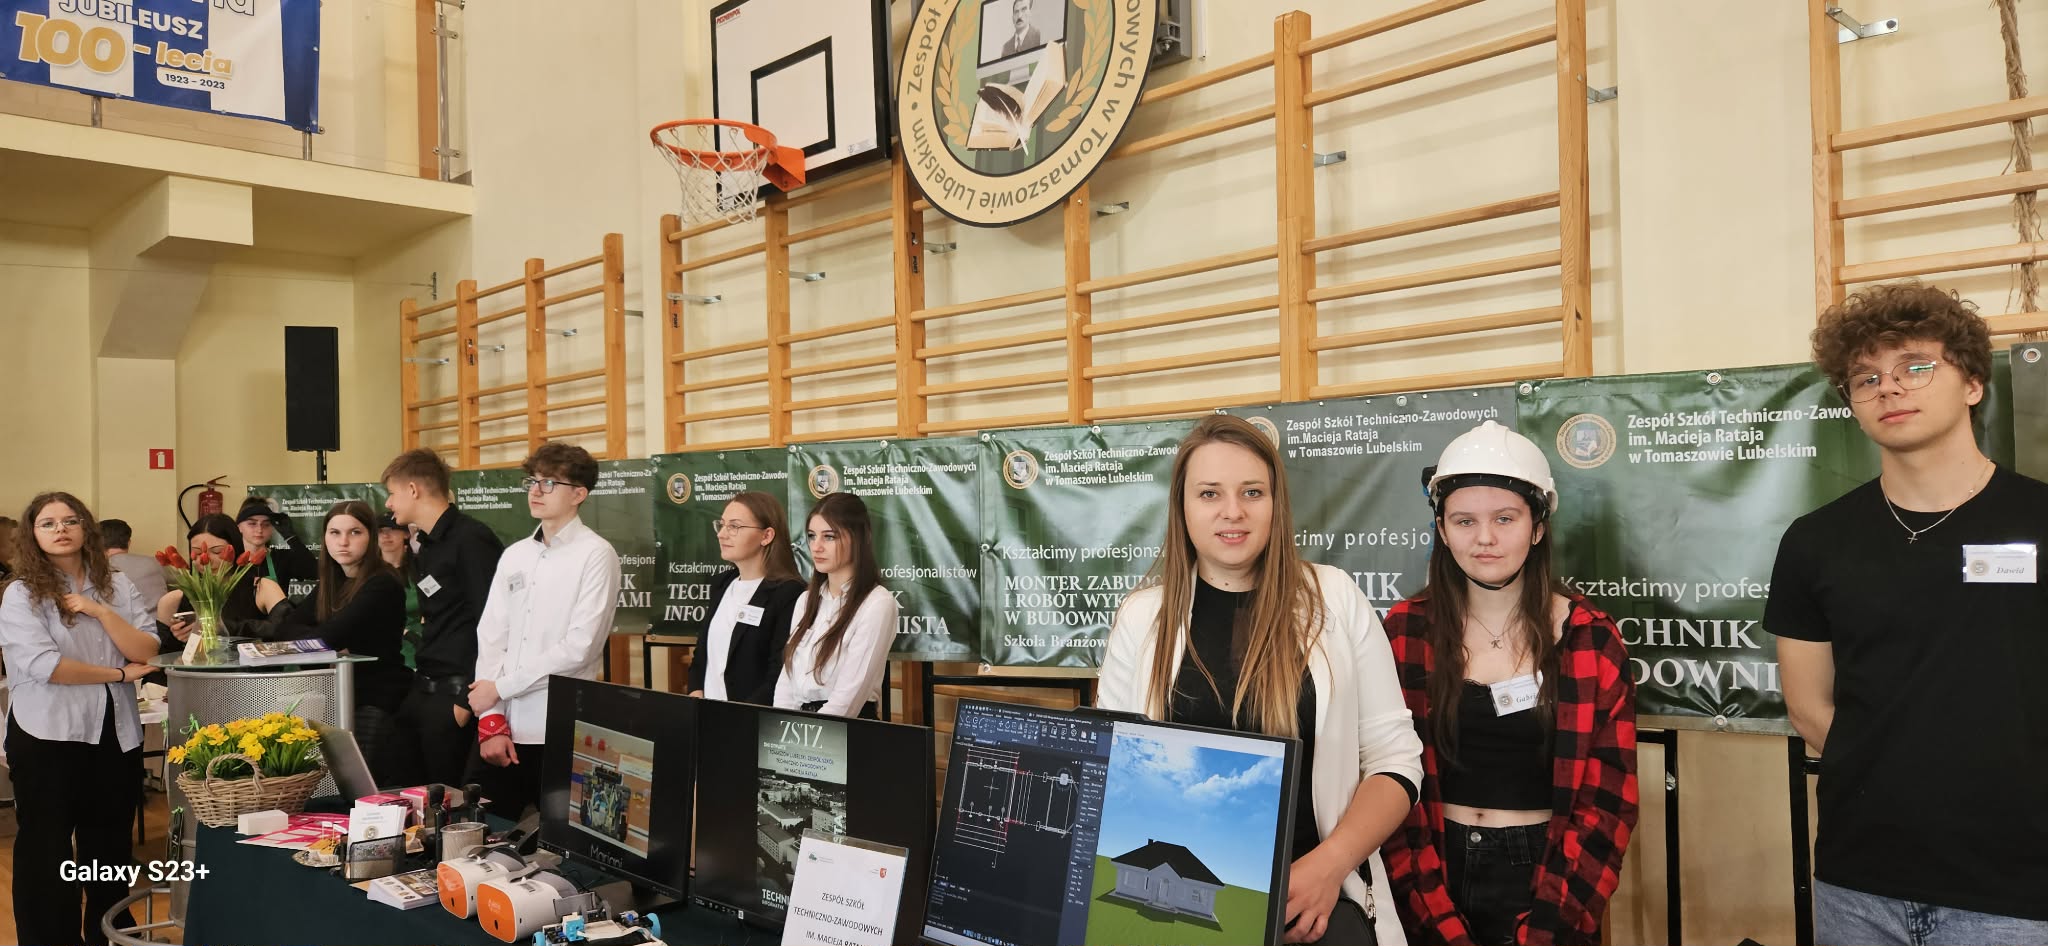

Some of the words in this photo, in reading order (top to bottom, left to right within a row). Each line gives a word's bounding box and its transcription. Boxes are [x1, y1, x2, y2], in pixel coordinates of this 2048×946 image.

[58, 0, 203, 39] JUBILEUSZ
[16, 11, 127, 74] 100
[156, 41, 233, 74] lecia
[907, 8, 942, 95] Zespół
[165, 73, 189, 85] 1923
[199, 79, 226, 89] 2023
[1101, 98, 1121, 123] w
[911, 118, 975, 210] Lubelskim
[979, 127, 1109, 214] Tomaszowie
[1286, 419, 1321, 432] Zespół
[1324, 416, 1353, 428] Szkół
[1355, 406, 1498, 426] Techniczno-Zawodowych
[1627, 414, 1675, 431] Zespół
[1677, 411, 1715, 427] Szkół
[1345, 429, 1379, 442] Rataja
[1628, 433, 1652, 446] im.
[1655, 430, 1712, 447] Macieja
[1715, 427, 1764, 446] Rataja
[1044, 451, 1072, 463] Zespół
[1072, 449, 1096, 461] Szkół
[1288, 450, 1297, 458] w
[1299, 443, 1363, 458] Tomaszowie
[1366, 440, 1422, 454] Lubelskim
[1628, 453, 1640, 463] w
[1644, 447, 1734, 463] Tomaszowie
[1737, 443, 1817, 460] Lubelskim
[843, 465, 867, 477] Zespół
[867, 464, 886, 475] Szkół
[886, 461, 977, 474] Techniczno-Zawodowych
[1045, 464, 1059, 474] im.
[1061, 462, 1093, 474] Macieja
[1095, 461, 1123, 472] Rataja
[694, 473, 713, 483] Zespół
[713, 472, 729, 482] Szkół
[844, 477, 856, 486] im.
[857, 475, 883, 487] Macieja
[885, 475, 909, 485] Rataja
[1055, 474, 1107, 486] Tomaszowie
[1108, 472, 1153, 483] Lubelskim
[695, 484, 704, 492] im.
[705, 483, 728, 492] Macieja
[729, 482, 747, 491] Rataja
[852, 486, 894, 497] Tomaszowie
[895, 485, 933, 496] Lubelskim
[1002, 544, 1077, 562] Kształcimy
[669, 562, 717, 576] Kształcimy
[667, 583, 712, 600] TECH
[1004, 575, 1083, 591] MONTER
[1005, 594, 1010, 608] I
[1015, 588, 1078, 608] ROBÓT
[663, 605, 709, 622] INFO
[1004, 611, 1022, 625] W
[780, 720, 823, 749] ZSTZ
[821, 892, 845, 905] ZESPÓŁ
[845, 897, 865, 910] SZKÓŁ
[794, 906, 884, 937] TECHNICZNO-ZAWODOWYCH
[806, 930, 816, 940] IM.
[817, 933, 843, 946] MACIEJA
